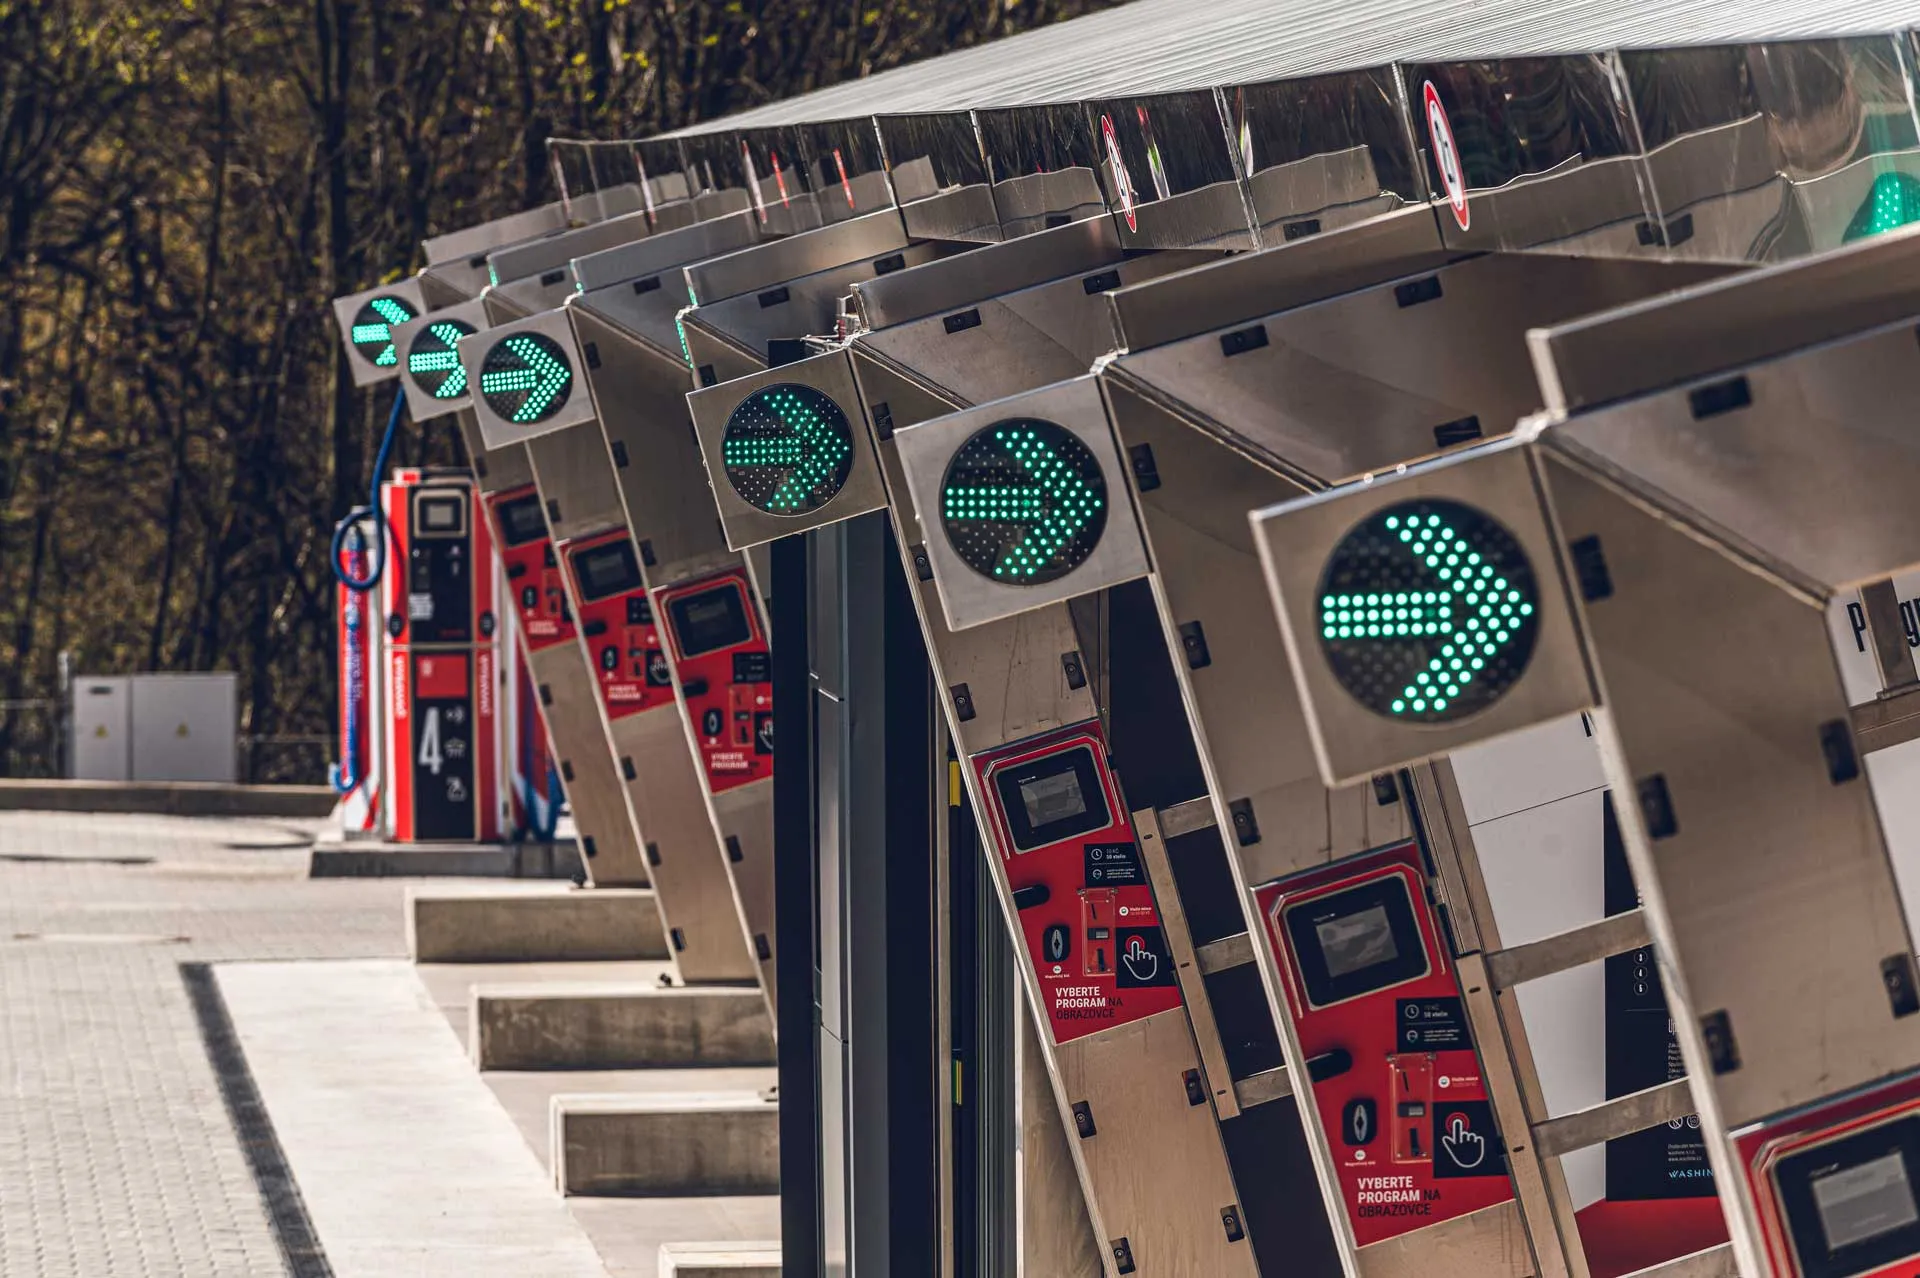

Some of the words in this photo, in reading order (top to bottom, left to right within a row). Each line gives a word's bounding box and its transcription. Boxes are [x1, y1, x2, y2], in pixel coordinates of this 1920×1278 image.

[419, 706, 443, 774] 4
[1055, 986, 1100, 998] VYBERTE
[1055, 997, 1106, 1009] PROGRAM
[1108, 997, 1123, 1007] NA
[1055, 1008, 1115, 1020] OBRAZOVCE
[1668, 1168, 1714, 1178] WASHIN
[1357, 1176, 1413, 1190] VYBERTE
[1357, 1189, 1420, 1204] PROGRAM
[1423, 1189, 1441, 1201] NA
[1357, 1203, 1432, 1218] OBRAZOVCE
